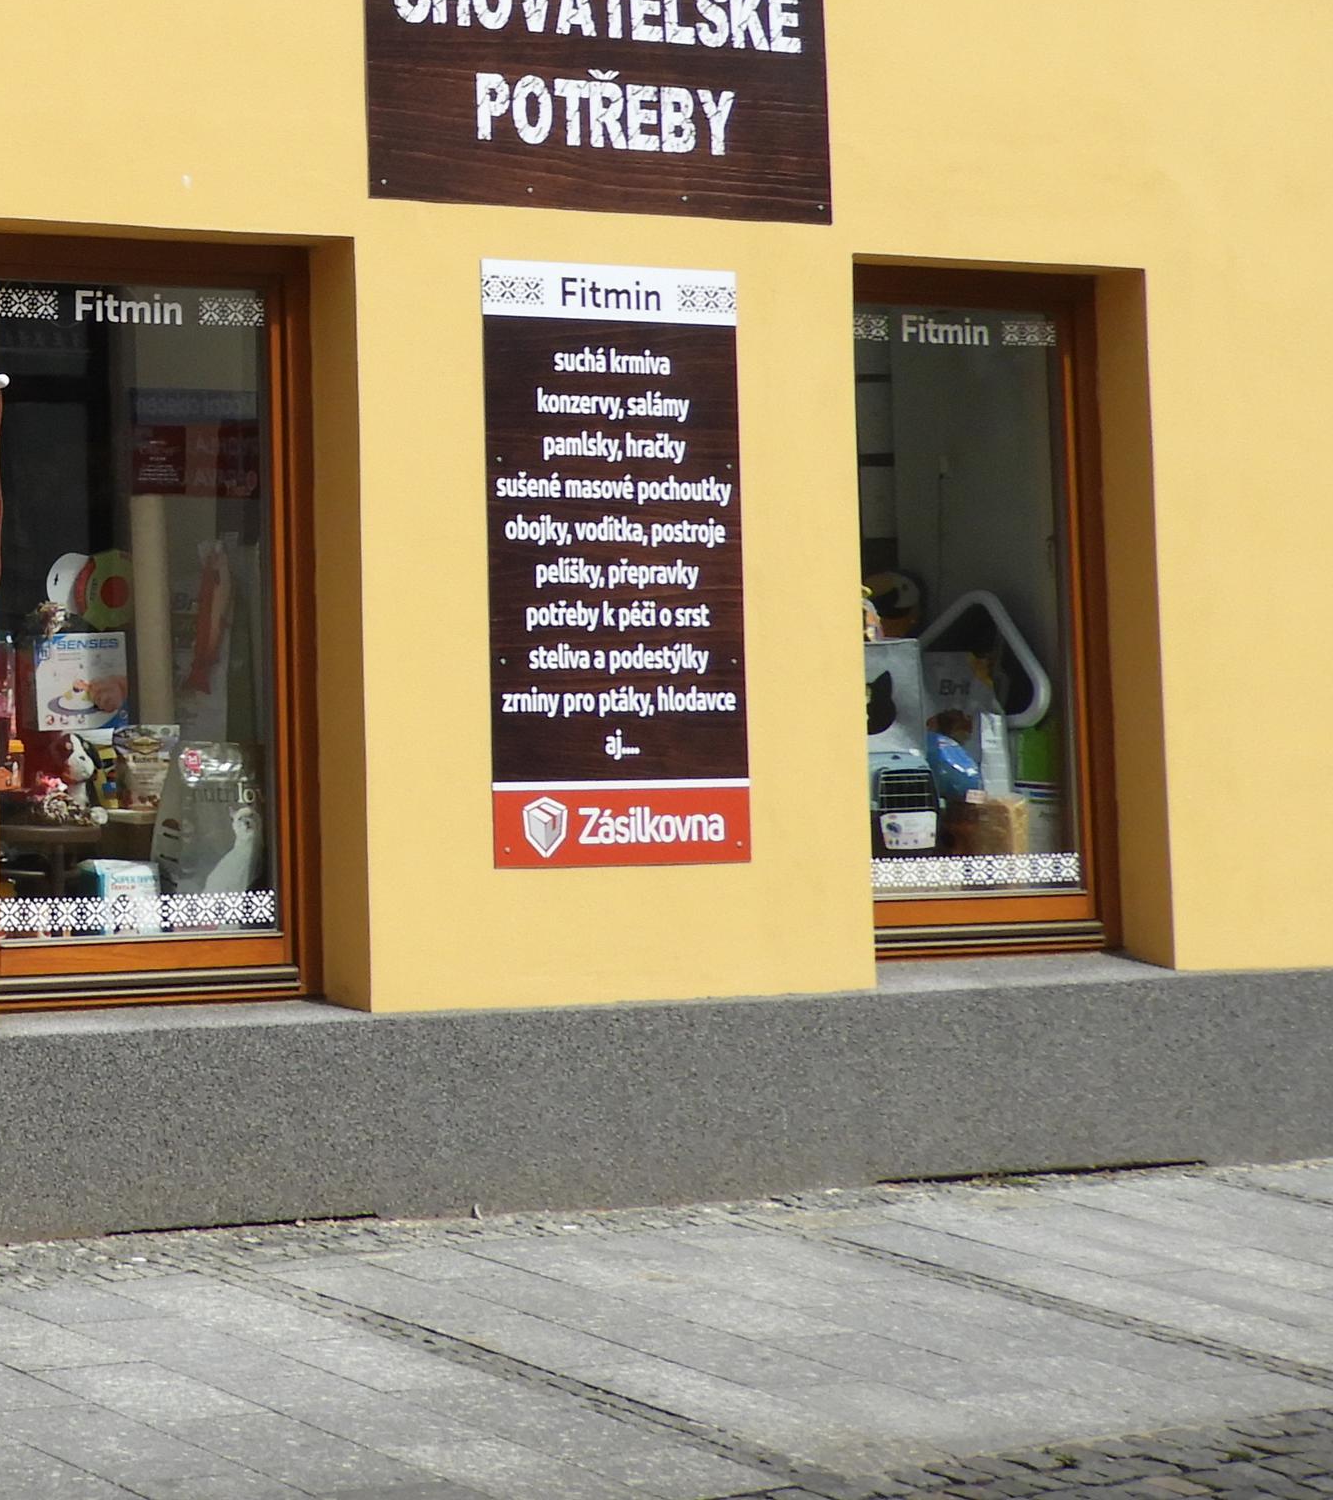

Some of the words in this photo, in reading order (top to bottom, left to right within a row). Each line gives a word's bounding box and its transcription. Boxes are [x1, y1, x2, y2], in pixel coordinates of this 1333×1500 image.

[475, 69, 735, 155] POTŘEBY
[74, 289, 183, 326] Fitmin
[561, 277, 661, 311] Fitmin
[901, 315, 990, 346] Fitmin
[554, 346, 606, 373] suchá
[610, 348, 671, 375] krmiva
[537, 387, 624, 420] konzervy,
[627, 391, 689, 422] salámy
[543, 431, 623, 462] pamlsky,
[625, 432, 686, 464] hračky
[496, 471, 561, 498] sušené
[565, 474, 634, 500] masové
[638, 475, 731, 506] pochoutky
[505, 514, 572, 546] obojky,
[575, 516, 648, 546] vodítka,
[651, 518, 725, 548] postroje
[535, 557, 604, 588] pelíšky,
[608, 558, 699, 589] přepravky
[526, 600, 599, 631] potřeby
[603, 600, 615, 626] k
[619, 600, 656, 631] péči
[659, 609, 672, 627] o
[675, 604, 710, 627] srst
[529, 643, 590, 670] steliva
[594, 651, 605, 670] a
[609, 643, 709, 674] podestýlky
[502, 687, 559, 717] zrniny
[563, 692, 595, 717] pro
[598, 686, 655, 717] ptáky,
[657, 685, 736, 712] hlodavce
[578, 806, 725, 845] Zásilkovna
